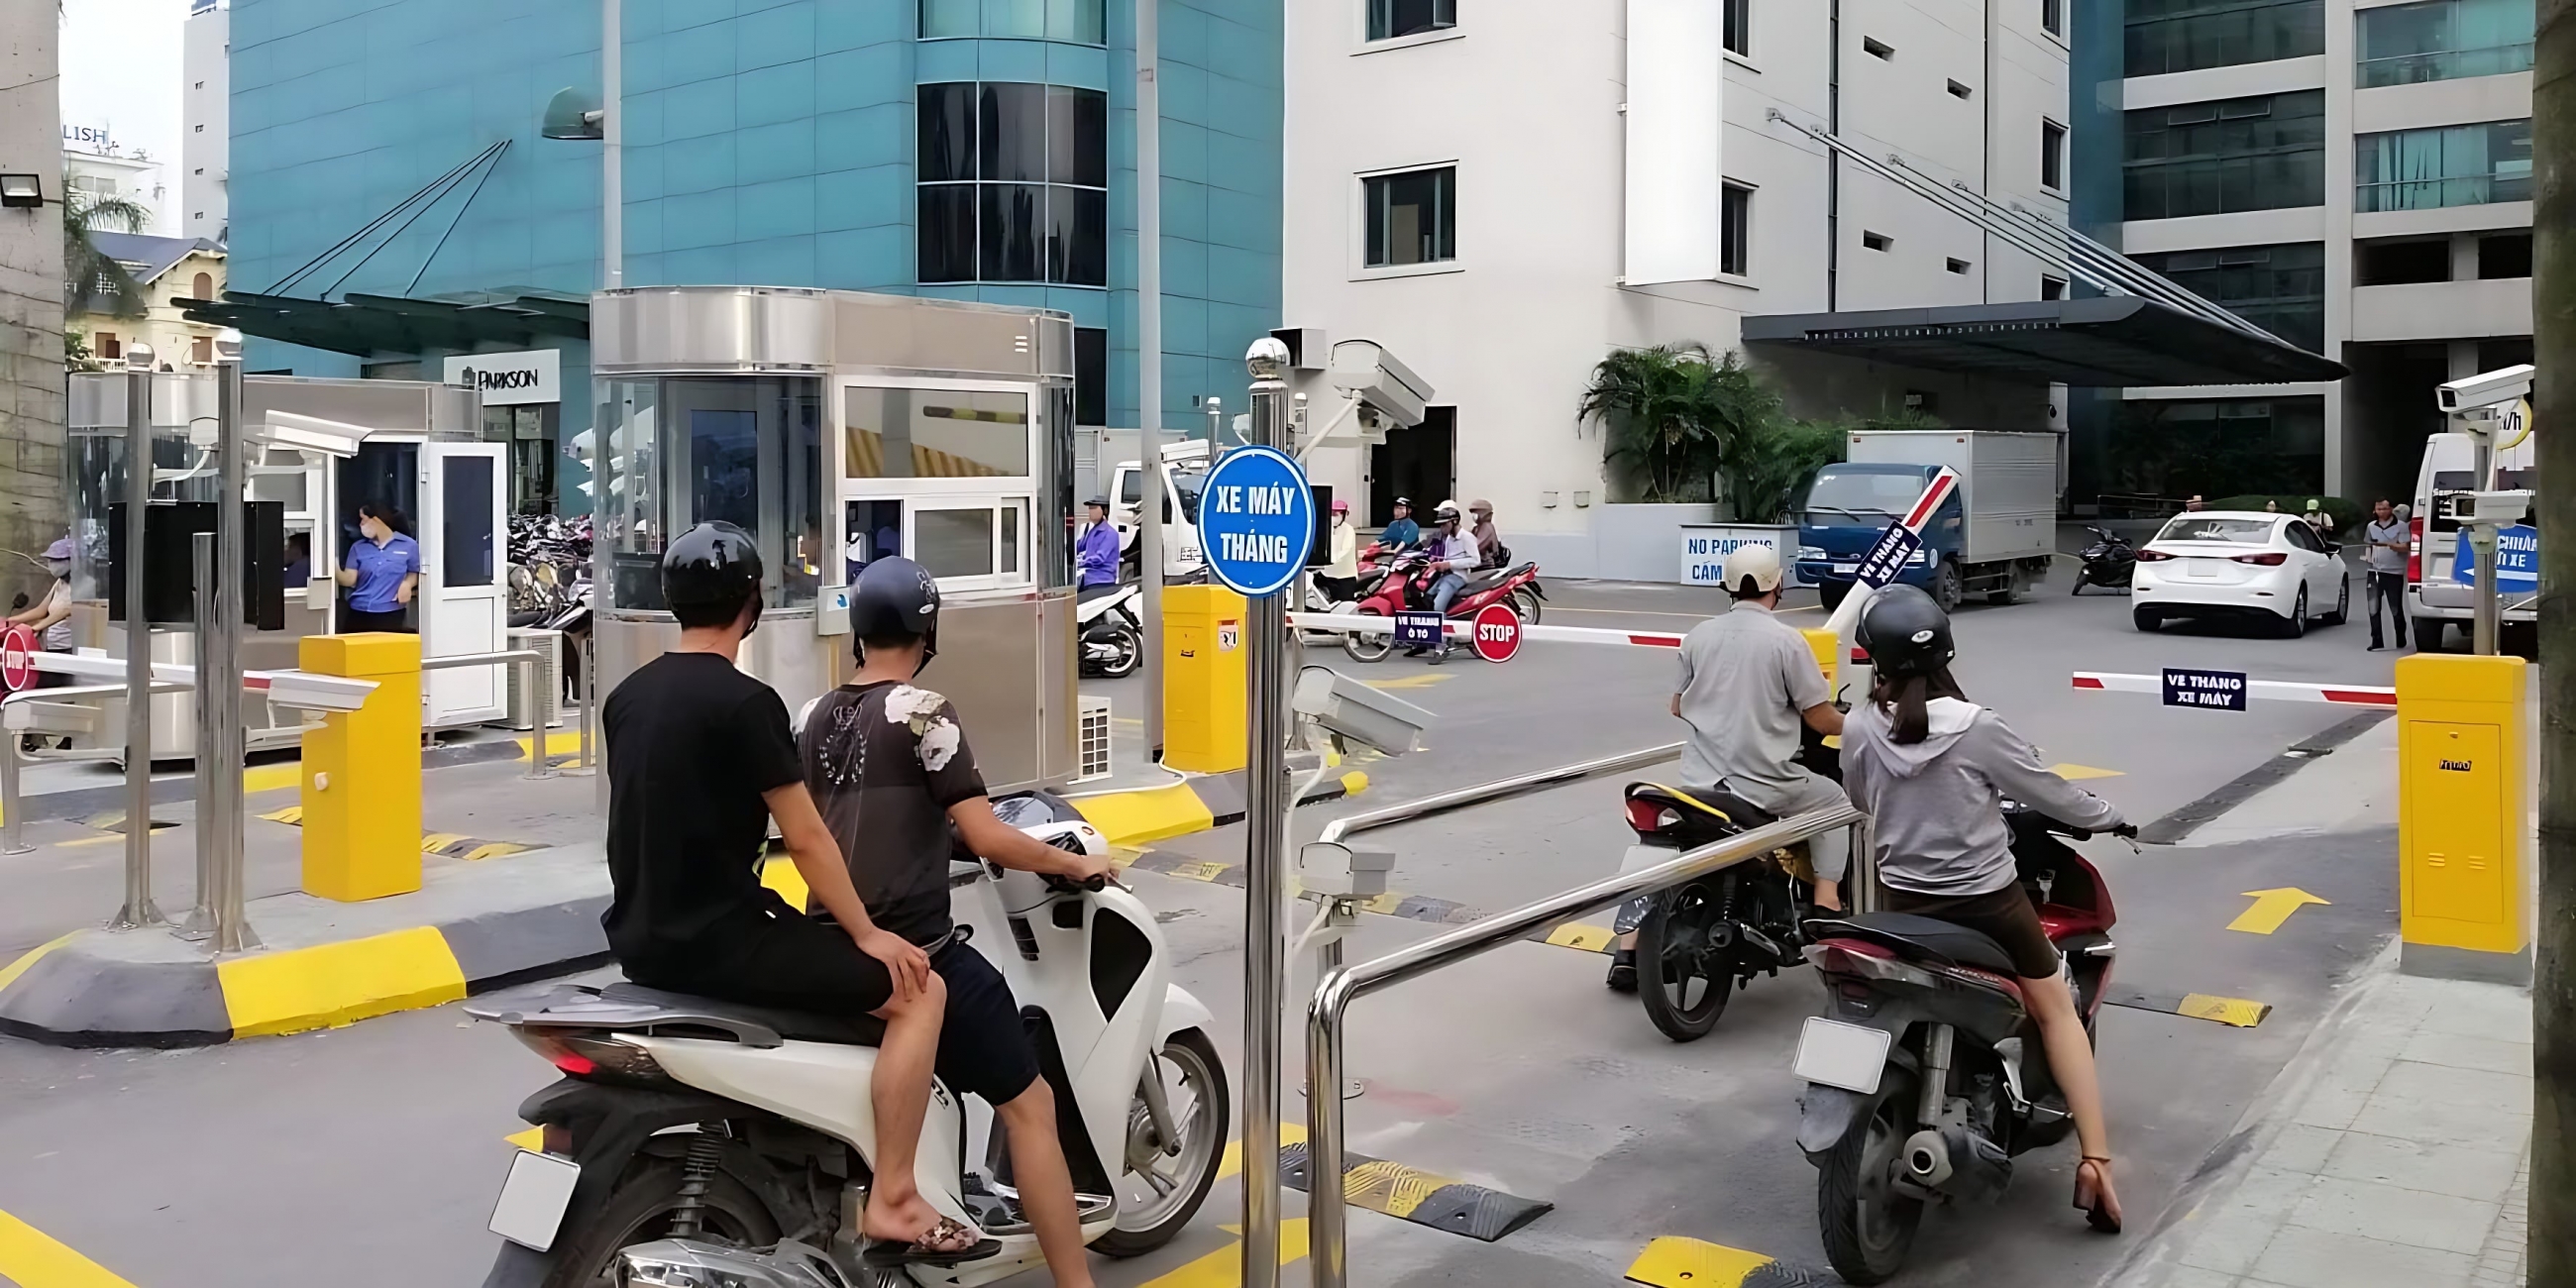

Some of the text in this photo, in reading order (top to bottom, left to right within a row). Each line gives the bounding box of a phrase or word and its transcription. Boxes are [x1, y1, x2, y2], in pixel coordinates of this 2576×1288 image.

[1216, 481, 1296, 515] XE MÁY
[1220, 528, 1288, 564] THÁNG
[1688, 538, 1707, 555] NO
[2509, 554, 2526, 568] XE
[1479, 623, 1515, 642] STOP
